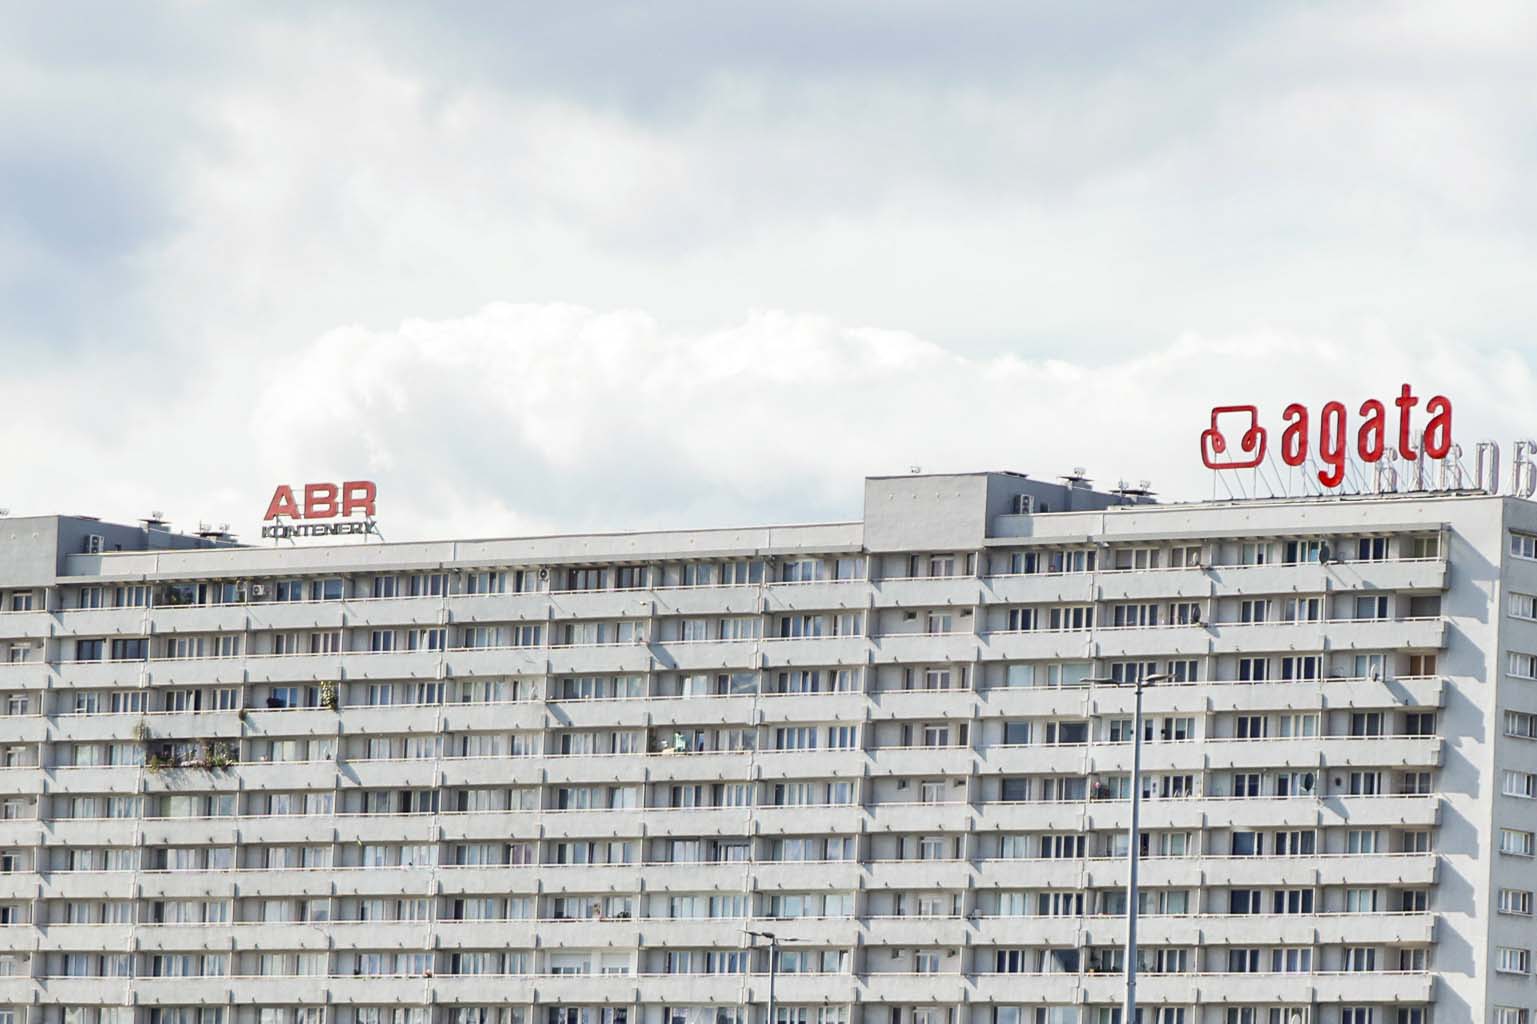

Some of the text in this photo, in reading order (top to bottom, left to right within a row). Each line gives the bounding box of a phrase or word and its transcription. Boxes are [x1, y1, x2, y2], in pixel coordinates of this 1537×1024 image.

[1281, 384, 1451, 487] agata
[264, 481, 376, 520] ABR
[262, 521, 377, 538] KONTENERY
